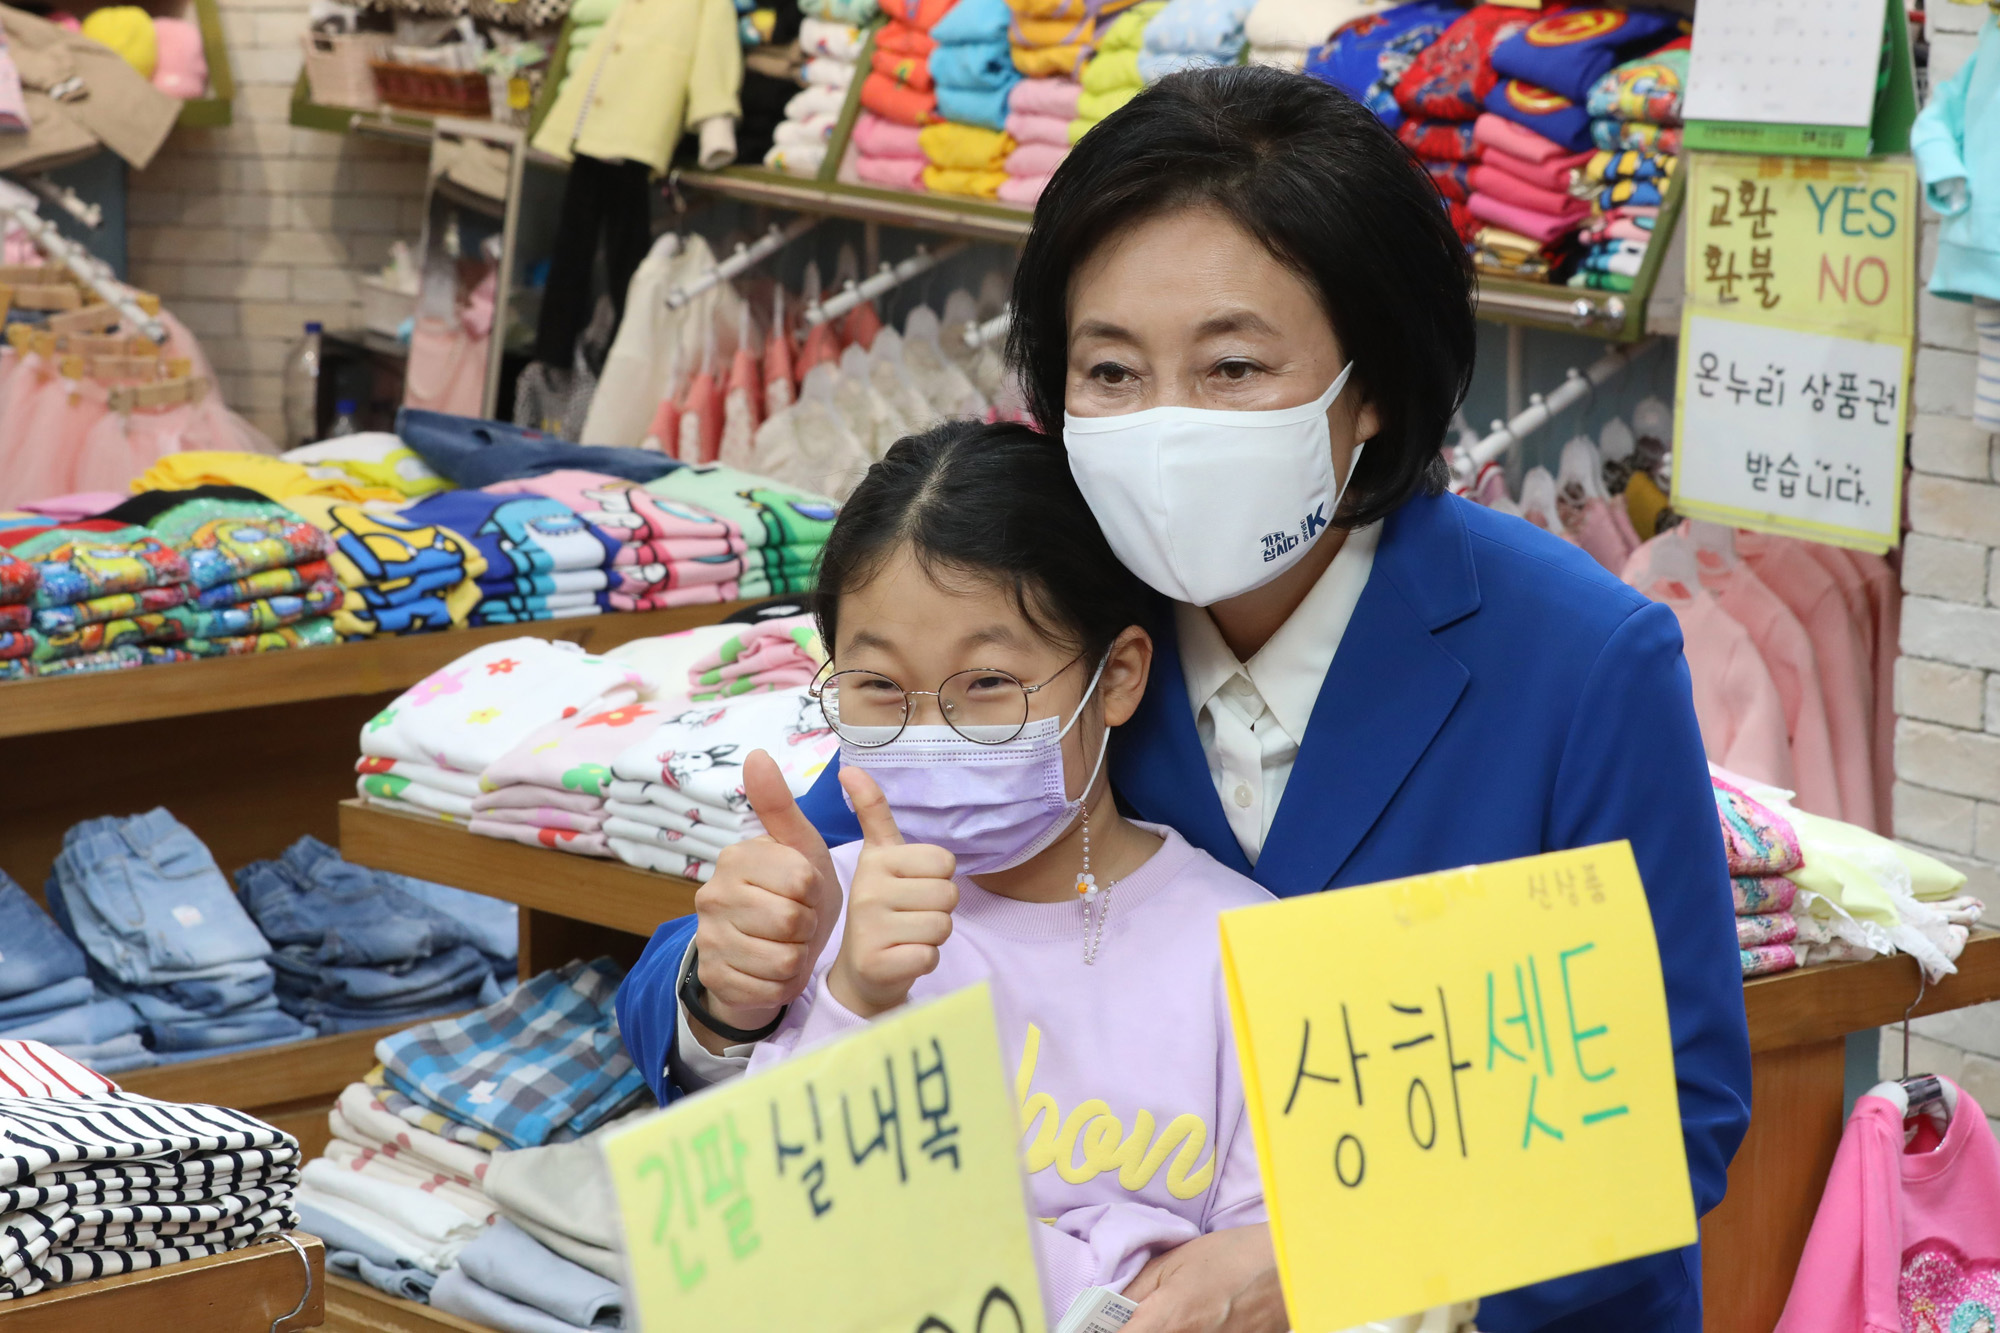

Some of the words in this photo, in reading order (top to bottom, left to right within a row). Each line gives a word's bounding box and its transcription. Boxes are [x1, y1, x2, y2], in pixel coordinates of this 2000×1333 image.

[1709, 179, 1777, 239] 교환
[1806, 184, 1896, 238] YES
[1704, 244, 1781, 309] 환불
[1818, 253, 1889, 306] NO
[1695, 352, 1785, 406] 온누리
[1801, 372, 1897, 425] 상품권
[1306, 501, 1327, 539] K
[769, 1035, 961, 1217] 실내복
